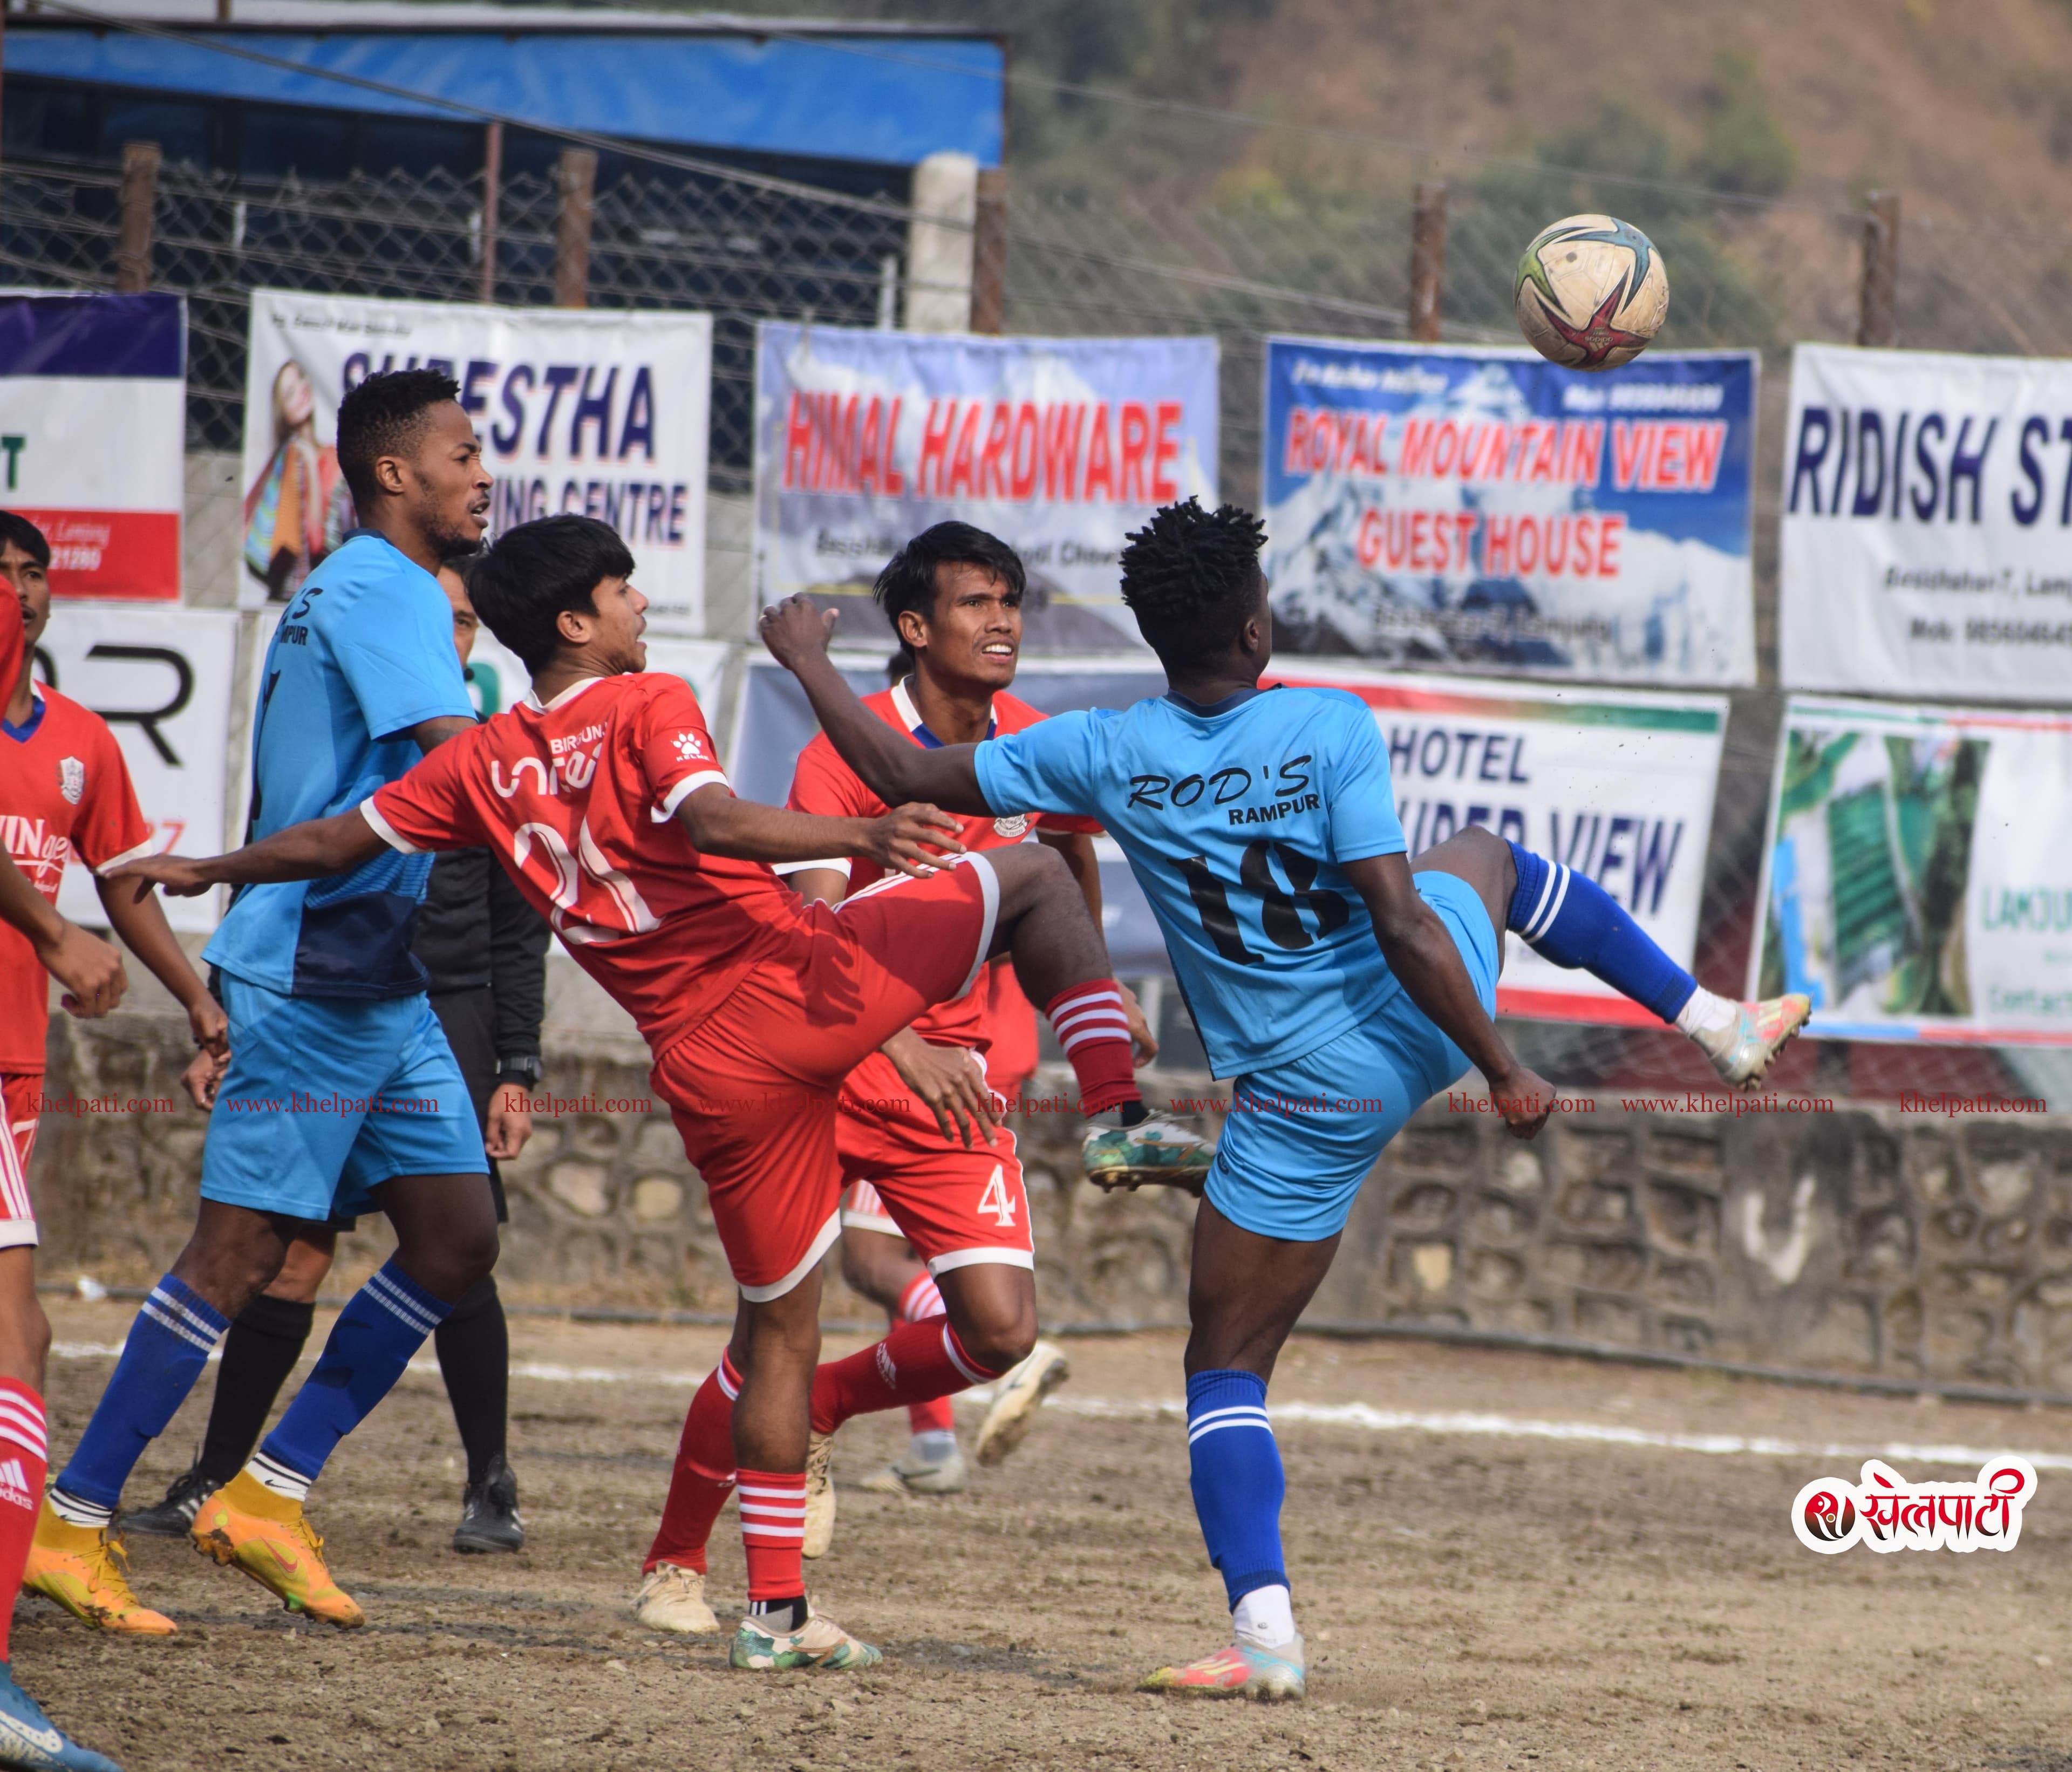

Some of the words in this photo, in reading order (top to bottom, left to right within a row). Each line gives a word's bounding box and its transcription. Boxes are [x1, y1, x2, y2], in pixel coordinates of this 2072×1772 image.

[917, 398, 1183, 502] HARDWARE
[1284, 408, 1388, 476] ROYAL
[1399, 417, 1606, 488] MOUNTAIN
[1612, 419, 1728, 492] VIEW
[1788, 406, 1999, 523] RIDISH
[1356, 507, 1477, 570] GUEST
[1483, 513, 1625, 580] HOUSE
[1127, 754, 1312, 810] ROD'S
[1391, 726, 1529, 784] HOTEL
[1228, 793, 1320, 826] RAMPUR
[1551, 809, 1686, 916] VIEW
[1166, 840, 1349, 966] 18
[978, 1164, 1017, 1227] 4
